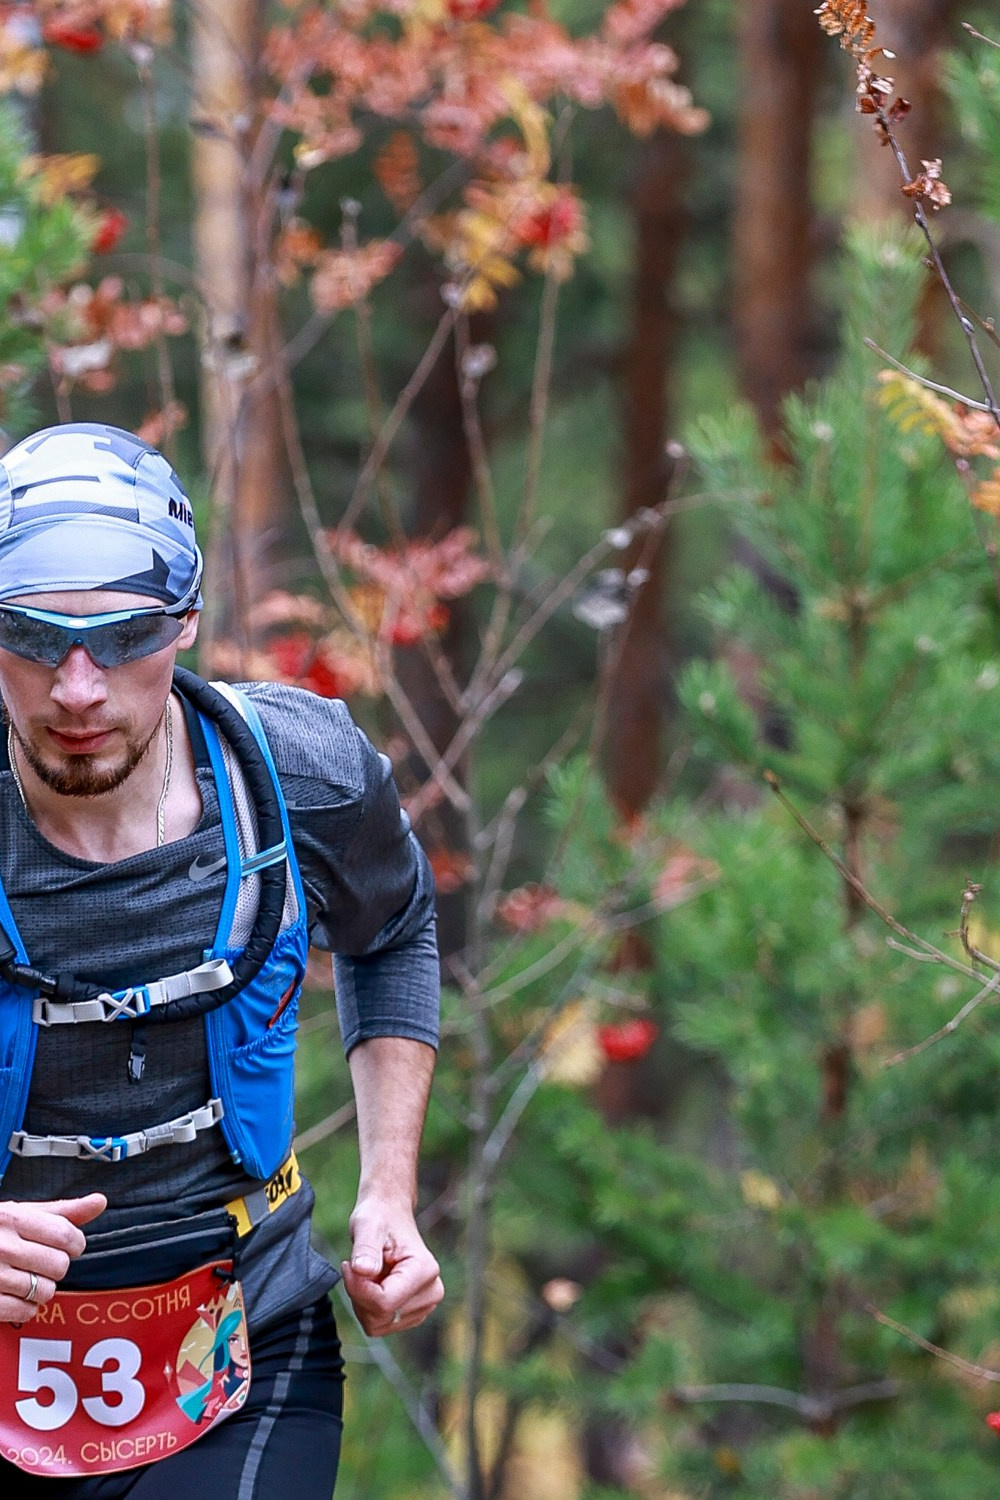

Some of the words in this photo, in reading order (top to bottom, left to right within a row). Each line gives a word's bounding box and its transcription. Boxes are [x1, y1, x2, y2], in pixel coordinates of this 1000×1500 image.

[76, 1284, 191, 1325] С.СОТНЯ
[14, 1337, 146, 1431] 53
[80, 1431, 178, 1463] СЫСЕРТЬ
